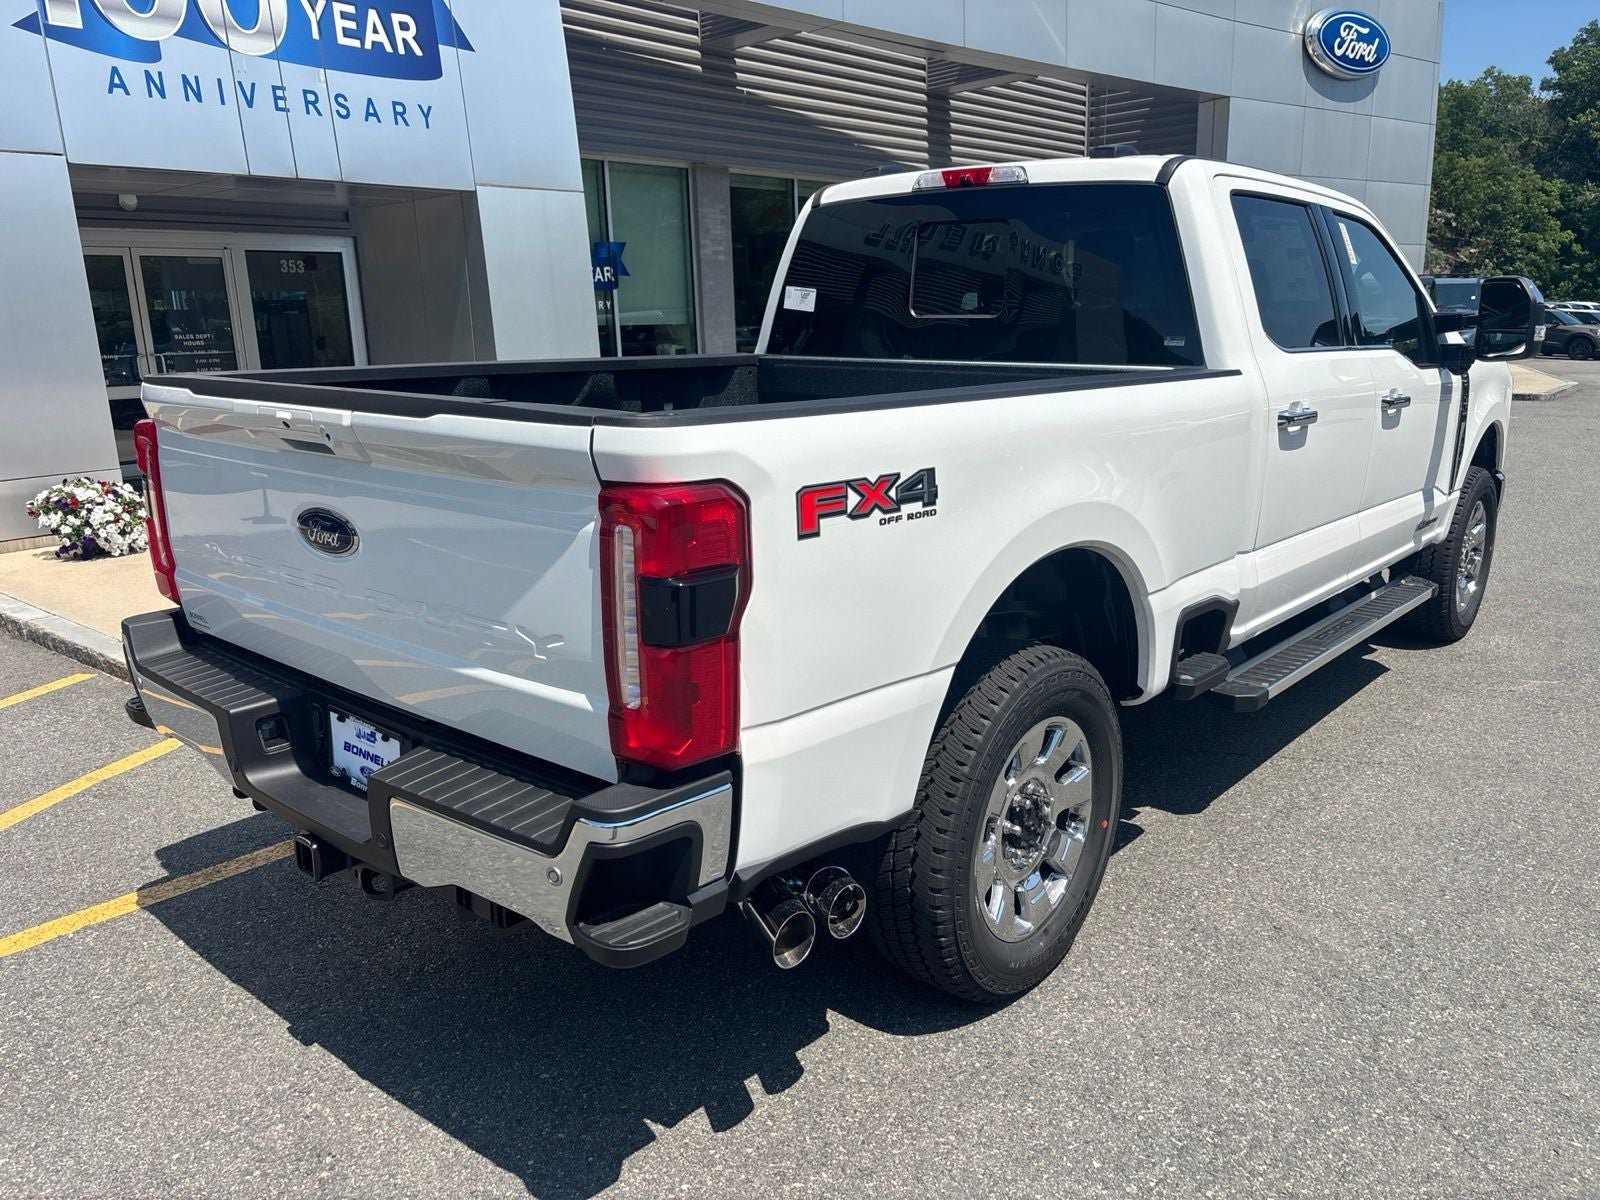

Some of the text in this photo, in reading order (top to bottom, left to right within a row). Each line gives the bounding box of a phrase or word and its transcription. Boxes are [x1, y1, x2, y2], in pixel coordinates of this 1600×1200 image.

[302, 0, 423, 56] YEAR
[1334, 21, 1380, 63] Ford
[107, 66, 433, 130] ANNIVERSARY
[280, 259, 305, 274] 353
[796, 467, 938, 541] FX4
[879, 508, 937, 526] OFF ROAD
[308, 516, 340, 547] Ford
[343, 740, 392, 767] BONNEL
